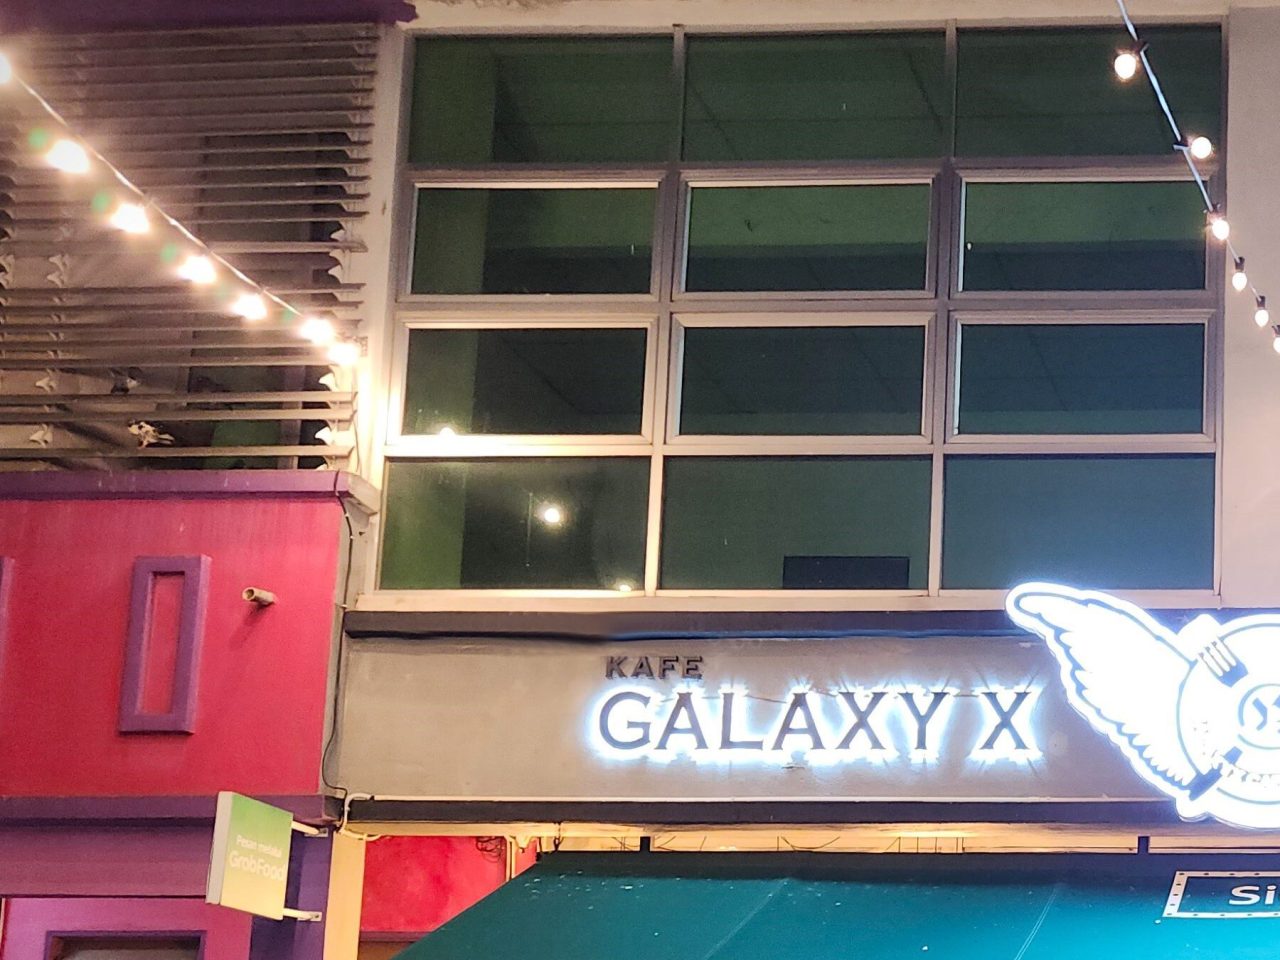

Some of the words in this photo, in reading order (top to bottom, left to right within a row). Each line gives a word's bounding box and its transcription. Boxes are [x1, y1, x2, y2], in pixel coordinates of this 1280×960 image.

[605, 656, 703, 679] KAFE
[599, 691, 951, 750] GALAXY
[980, 691, 1030, 750] X
[229, 850, 286, 881] GrabFood
